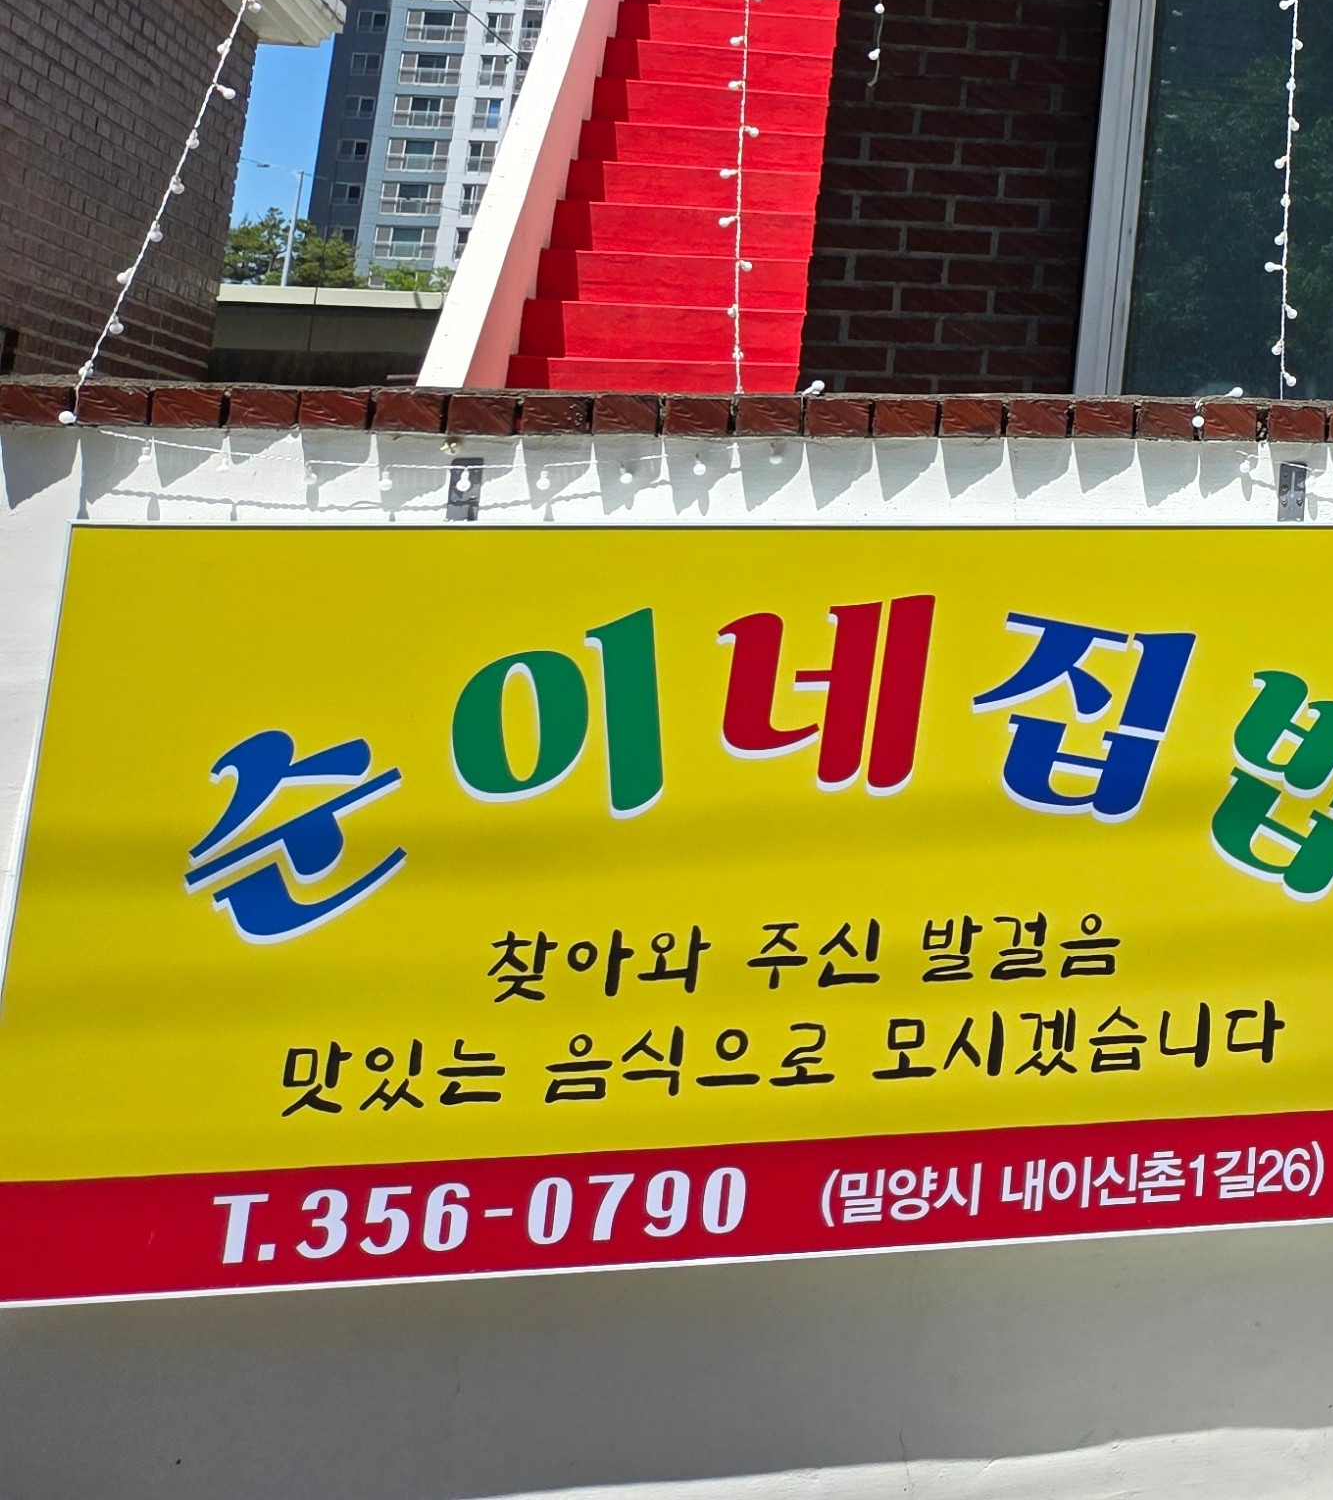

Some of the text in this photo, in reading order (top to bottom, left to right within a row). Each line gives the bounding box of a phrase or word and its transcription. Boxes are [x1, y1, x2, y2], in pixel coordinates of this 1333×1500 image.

[487, 911, 1121, 1002] 찾아와 주신 발걸음
[281, 999, 1285, 1117] 맛있는 음식으로 모시겠습니다
[820, 1162, 984, 1228] (밀양시
